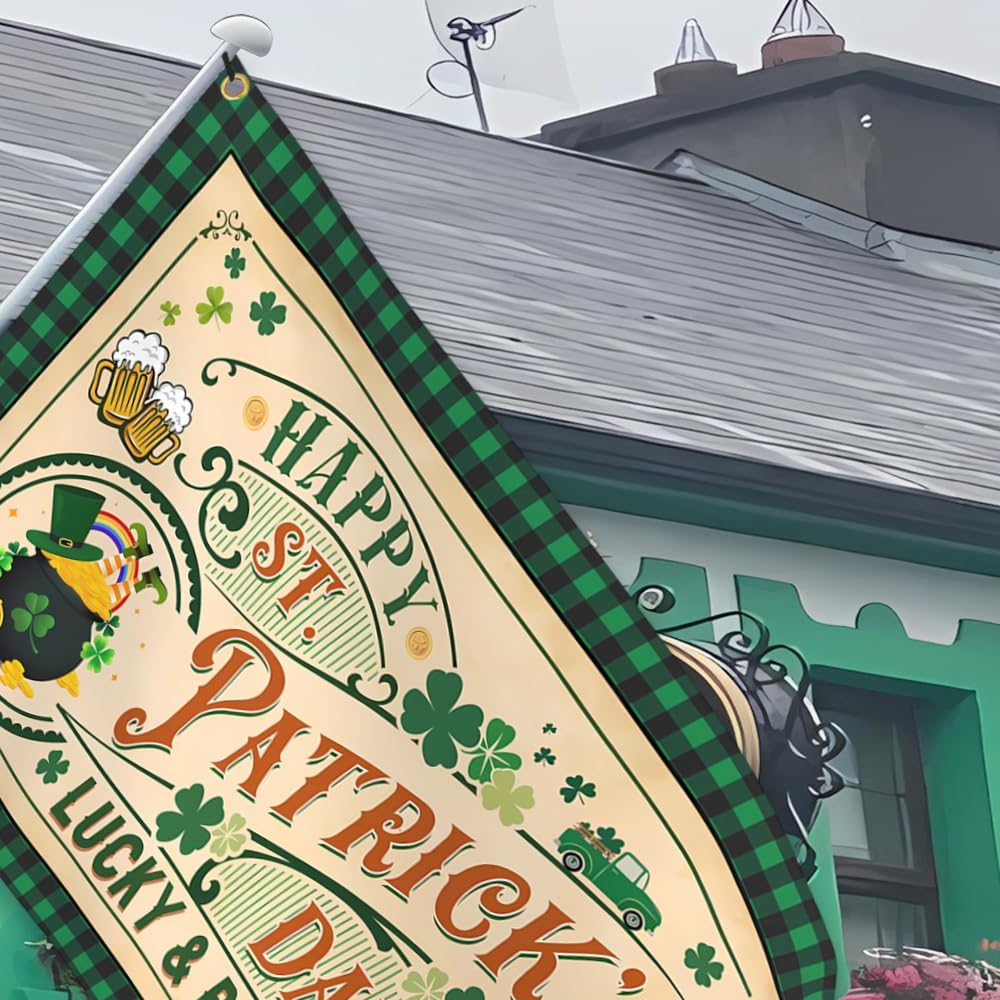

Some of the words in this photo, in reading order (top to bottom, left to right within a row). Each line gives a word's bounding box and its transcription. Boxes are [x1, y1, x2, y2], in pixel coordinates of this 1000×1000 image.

[251, 522, 347, 645] ST.
[260, 399, 439, 626] HAPPY
[48, 776, 187, 933] LUCKY
[160, 934, 210, 988] &
